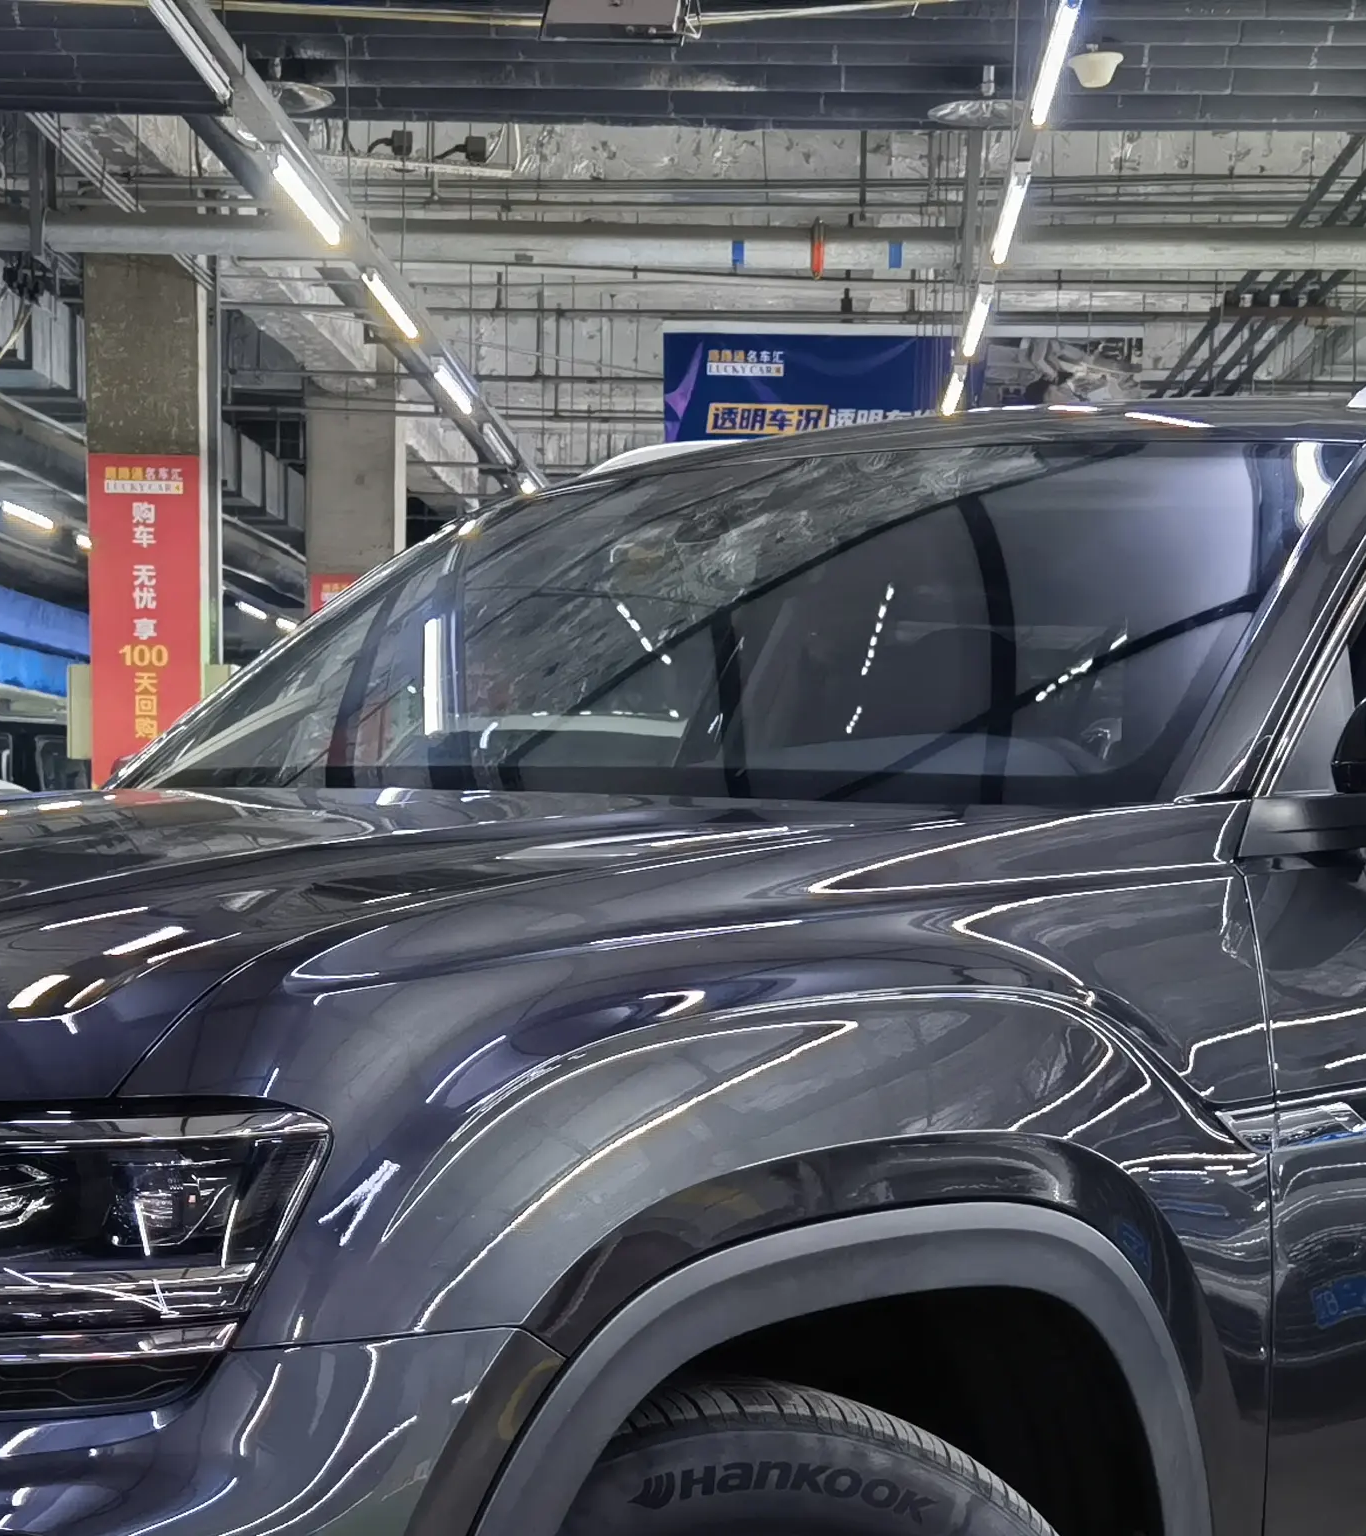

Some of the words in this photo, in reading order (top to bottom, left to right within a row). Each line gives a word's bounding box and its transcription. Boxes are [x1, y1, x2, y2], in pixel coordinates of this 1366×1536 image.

[712, 406, 824, 431] 透明车况
[829, 408, 936, 428] 透明
[105, 467, 183, 481] 名车汇
